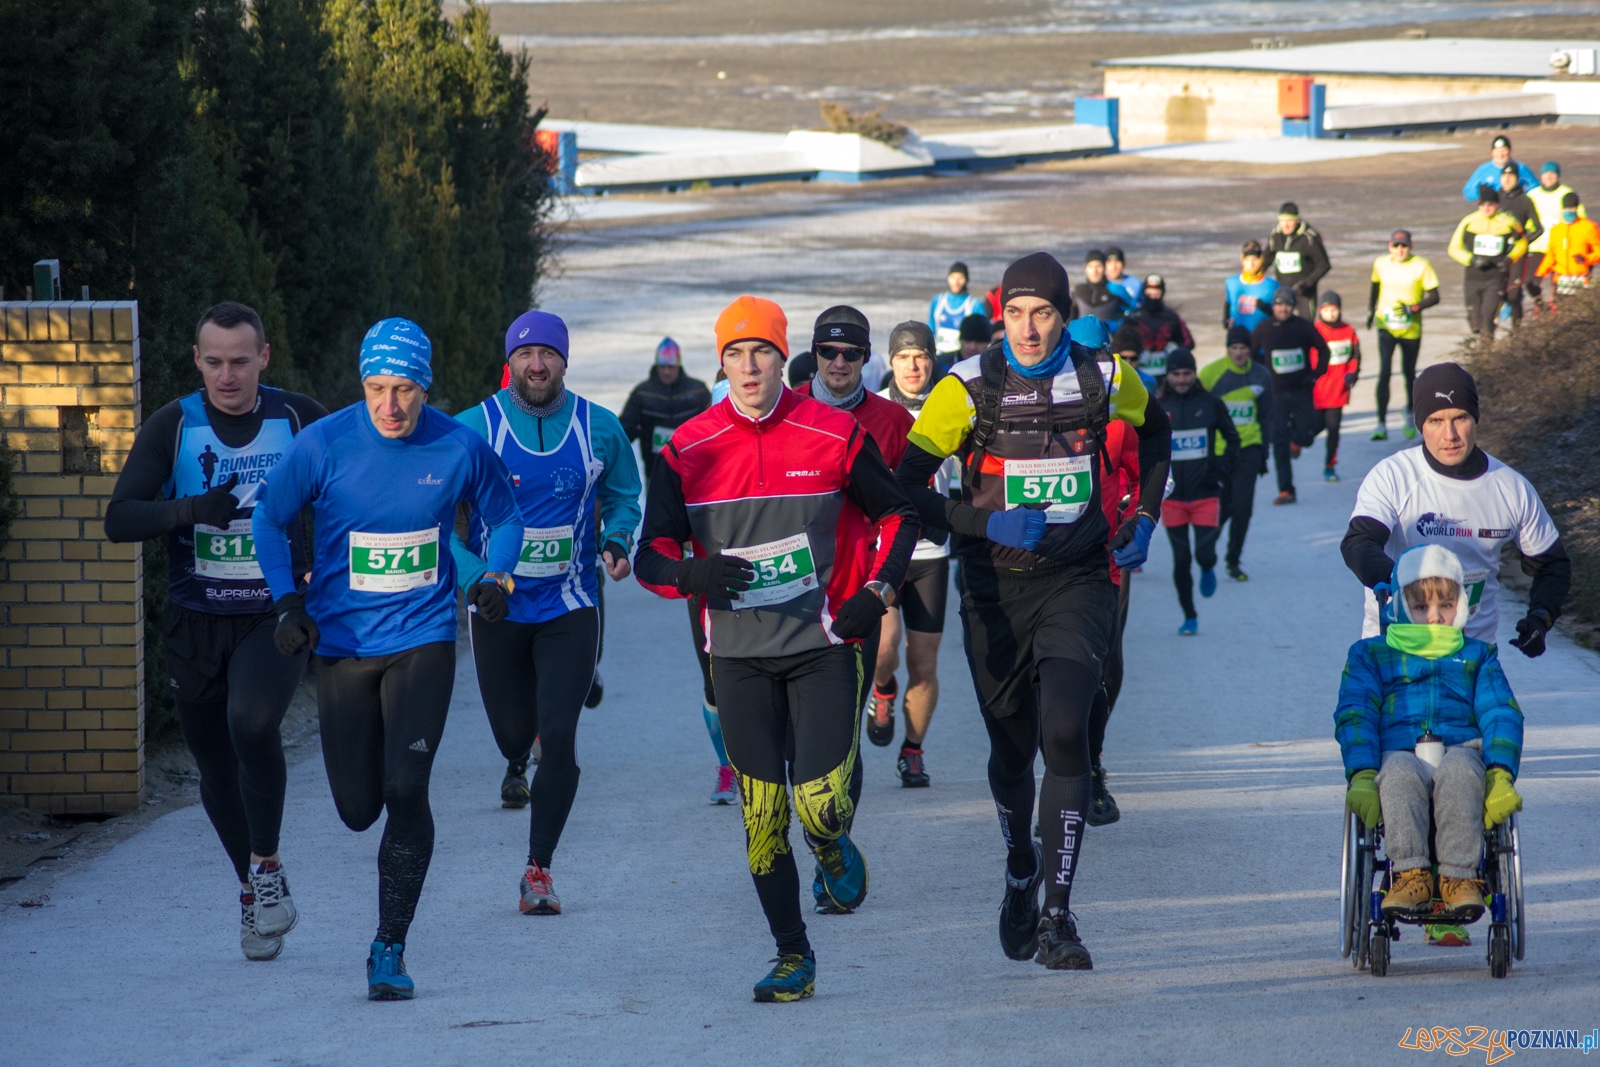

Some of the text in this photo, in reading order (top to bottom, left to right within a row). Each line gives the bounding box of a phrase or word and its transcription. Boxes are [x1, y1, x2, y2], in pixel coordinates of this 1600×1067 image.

[1175, 436, 1201, 449] 145
[219, 452, 282, 473] RUNNERS
[1048, 459, 1085, 468] SYLWESTROWY
[1023, 474, 1078, 499] 570
[392, 531, 433, 541] SYLWESTROWY
[1425, 525, 1473, 538] WORLD RUN
[210, 535, 257, 556] 817
[519, 540, 560, 559] 720
[759, 538, 801, 552] SYLWESTROWY
[367, 547, 420, 570] 571
[762, 579, 782, 588] KAMIL
[206, 587, 272, 599] SUPREMO
